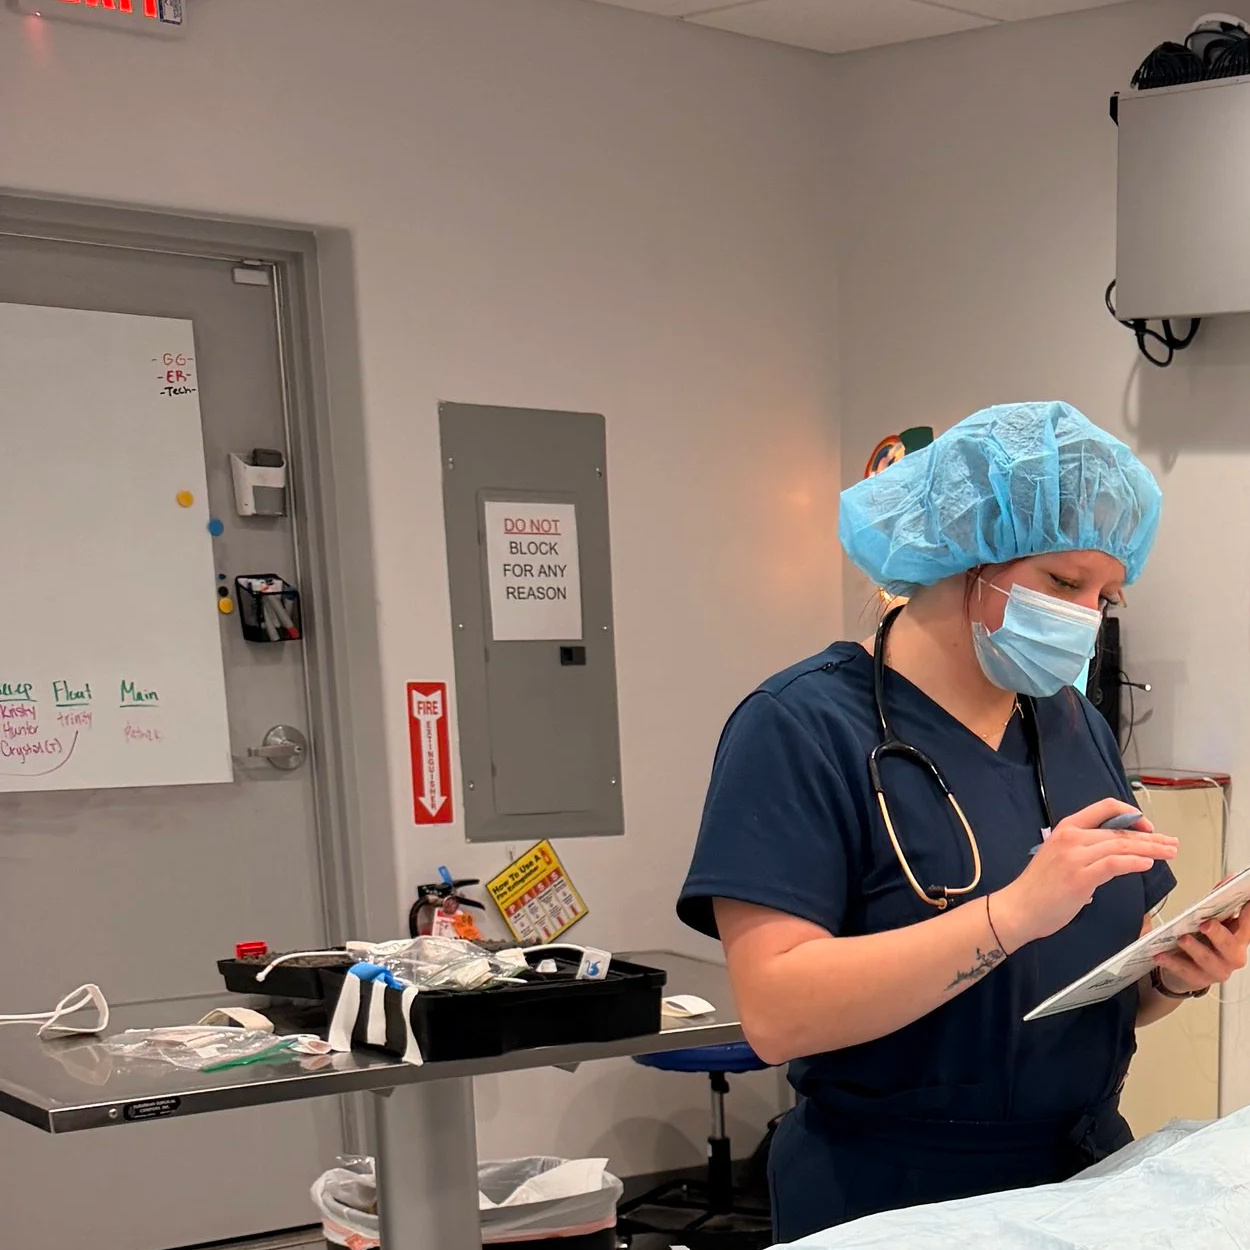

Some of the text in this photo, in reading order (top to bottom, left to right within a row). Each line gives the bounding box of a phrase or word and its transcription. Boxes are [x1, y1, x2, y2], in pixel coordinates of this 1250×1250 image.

[504, 518, 560, 533] DO NOT
[509, 541, 559, 555] BLOCK
[503, 563, 567, 578] FOR ANY
[506, 586, 567, 600] REASON
[53, 680, 92, 701] Float
[120, 680, 159, 701] Main
[417, 701, 439, 715] FIRE
[3, 723, 39, 739] Hunter
[426, 721, 437, 810] EXTINGUISHER
[492, 854, 542, 895] How To Use A
[509, 871, 559, 914] P A S S
